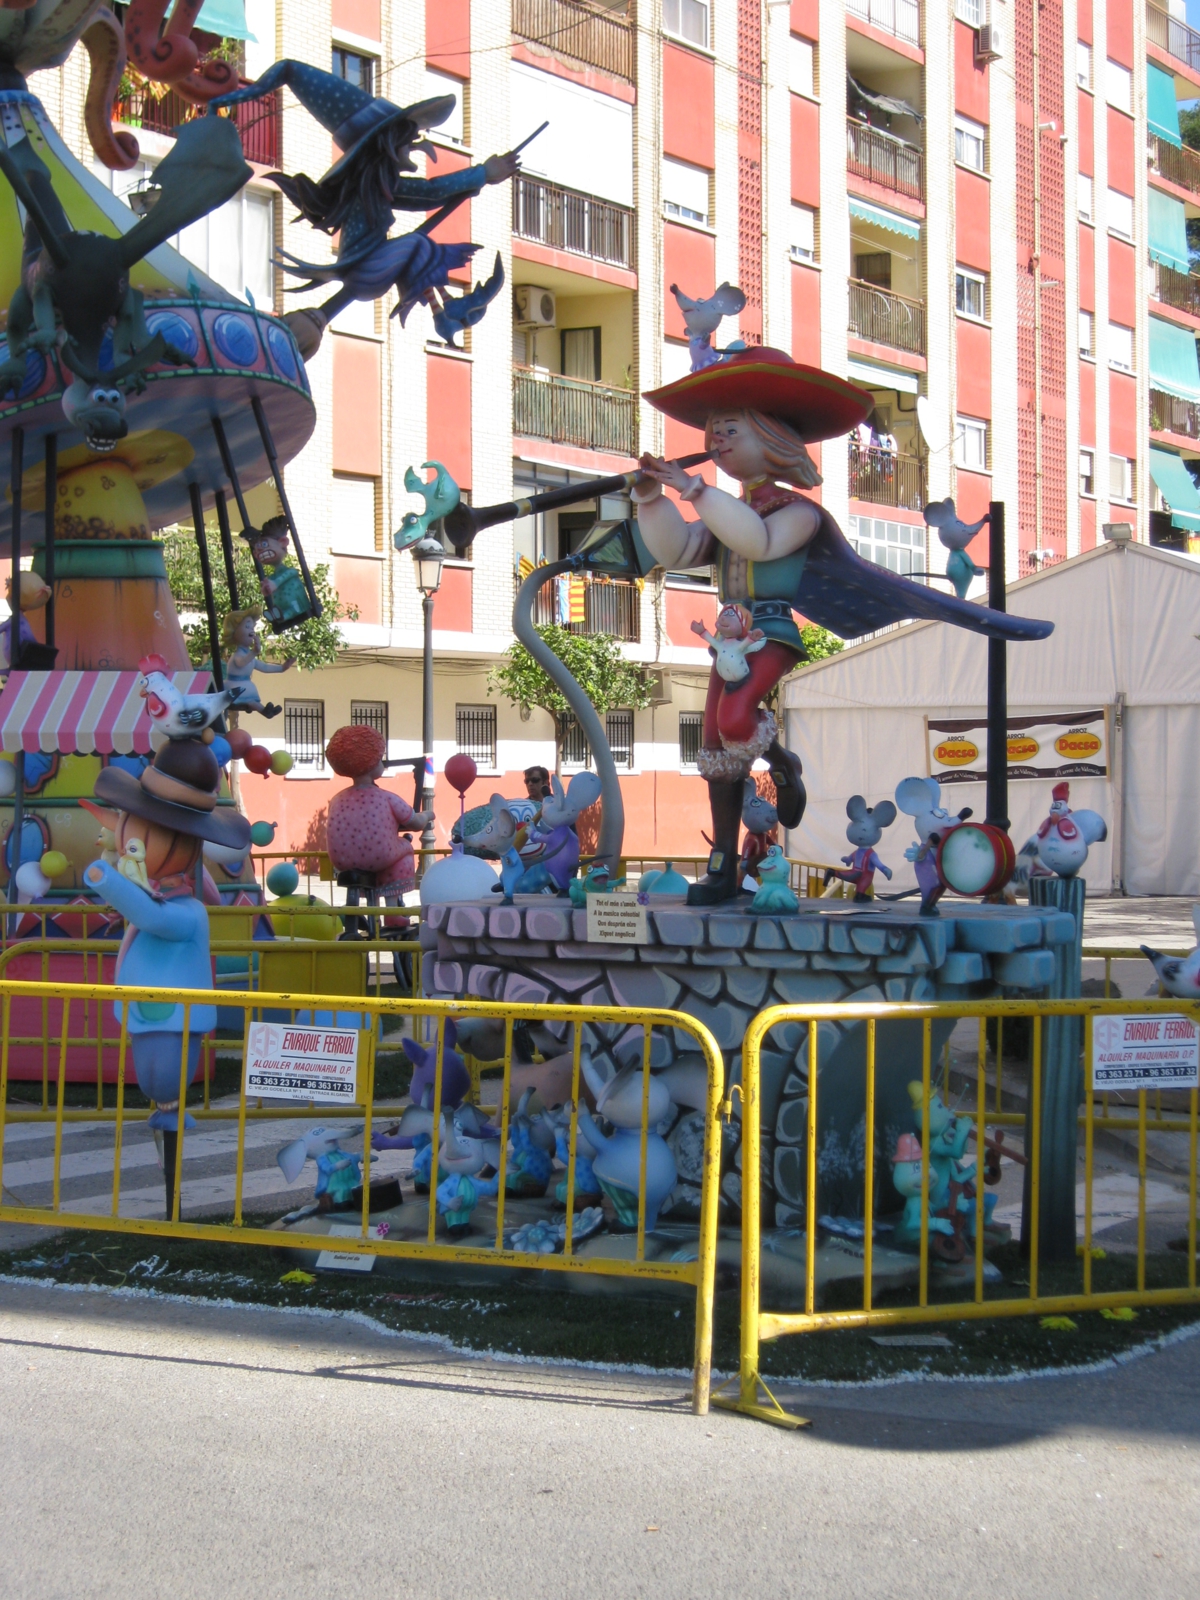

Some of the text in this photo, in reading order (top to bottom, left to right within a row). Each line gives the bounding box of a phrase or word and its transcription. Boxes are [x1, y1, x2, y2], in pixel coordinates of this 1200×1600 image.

[1008, 745, 1036, 754] acsa
[1059, 739, 1098, 751] Dacsa
[938, 747, 976, 758] Dacsa
[1124, 1021, 1196, 1042] ENRIQUE FERRIOL
[282, 1032, 354, 1054] ENRIQUE FERRIOL
[1098, 1053, 1132, 1062] ALQUILER
[1135, 1051, 1179, 1061] MAQUINARIA
[253, 1059, 291, 1069] ALQUILER
[293, 1062, 336, 1073] MAQUINARIA
